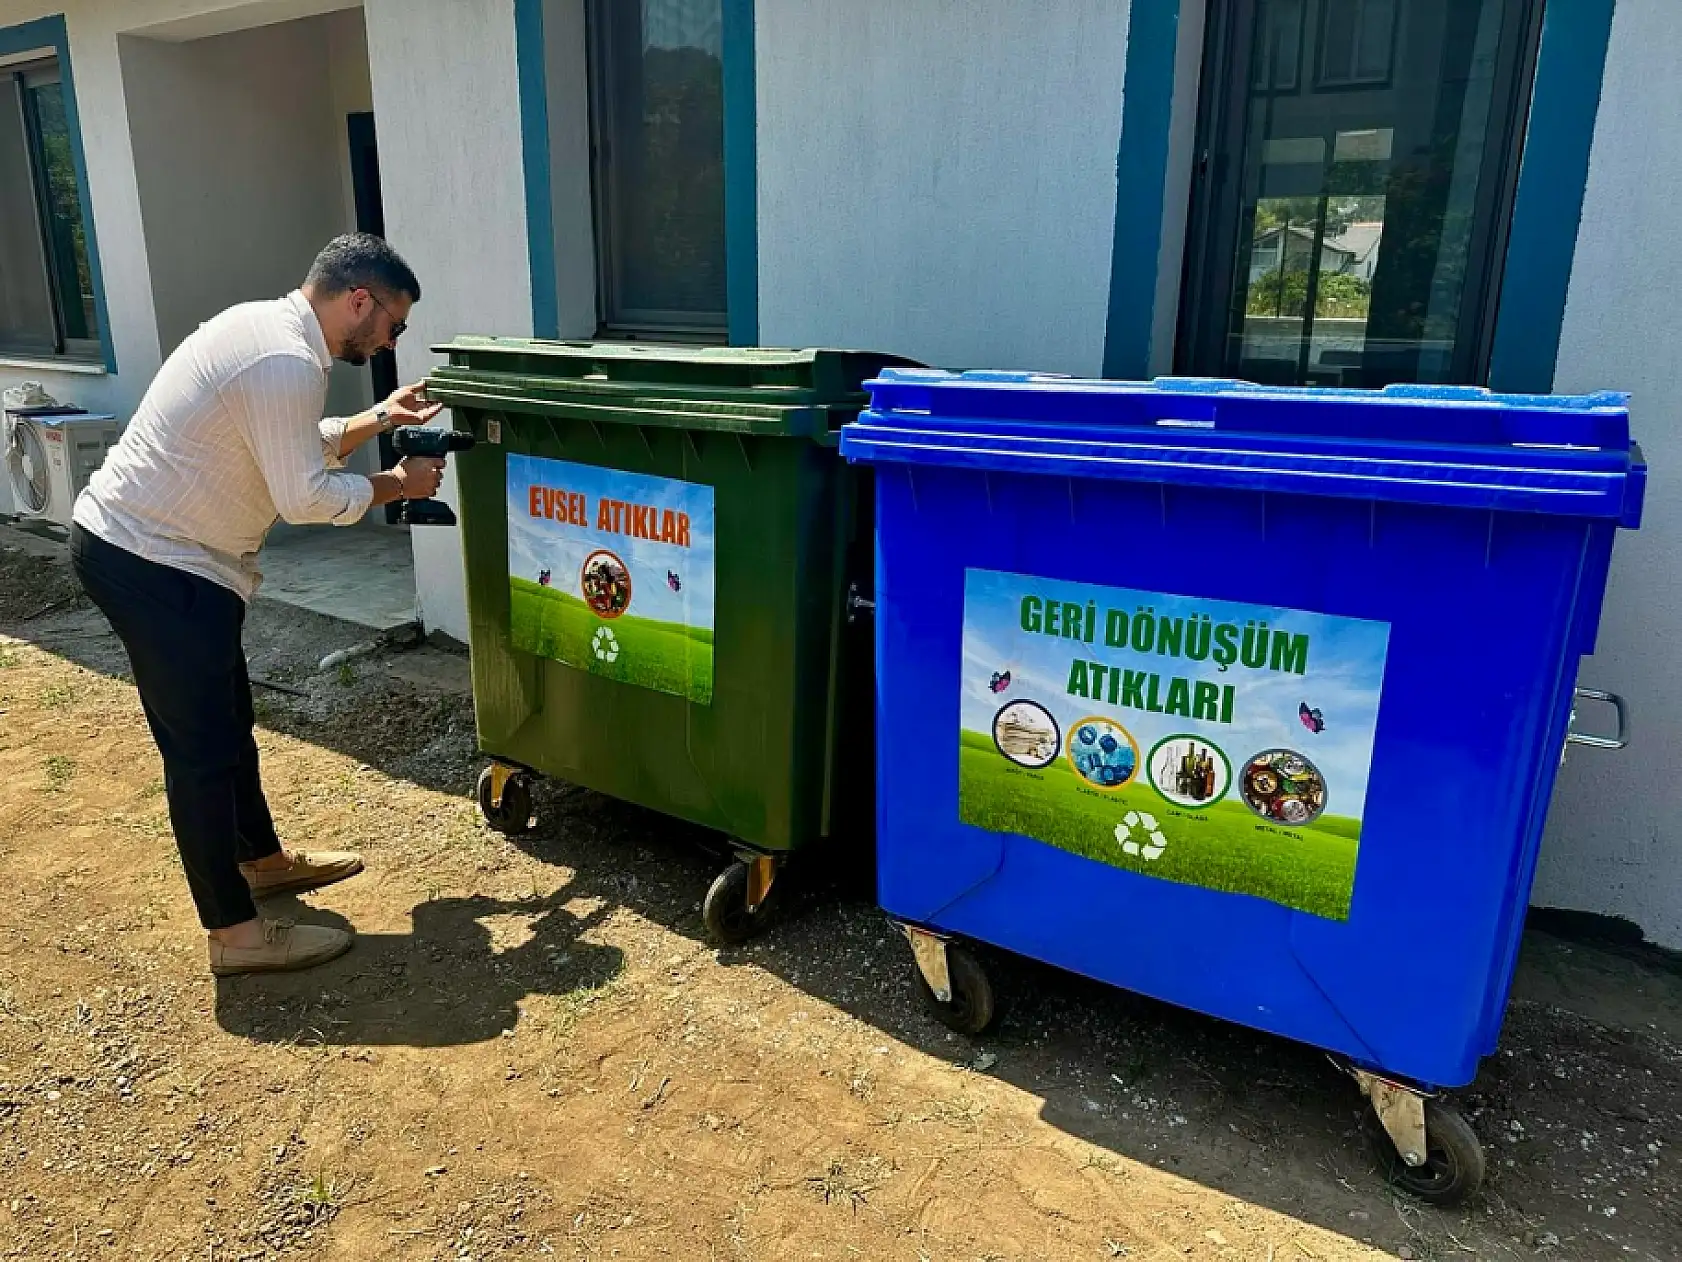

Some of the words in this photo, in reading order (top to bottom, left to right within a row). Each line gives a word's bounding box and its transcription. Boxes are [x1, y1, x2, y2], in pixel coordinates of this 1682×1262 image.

[529, 486, 588, 527] EVSEL
[598, 498, 691, 548] ATIKLAR
[1020, 596, 1096, 643] GERİ
[1105, 605, 1309, 675] DÖNÜŞÜM
[1067, 659, 1235, 724] ATIKLARI
